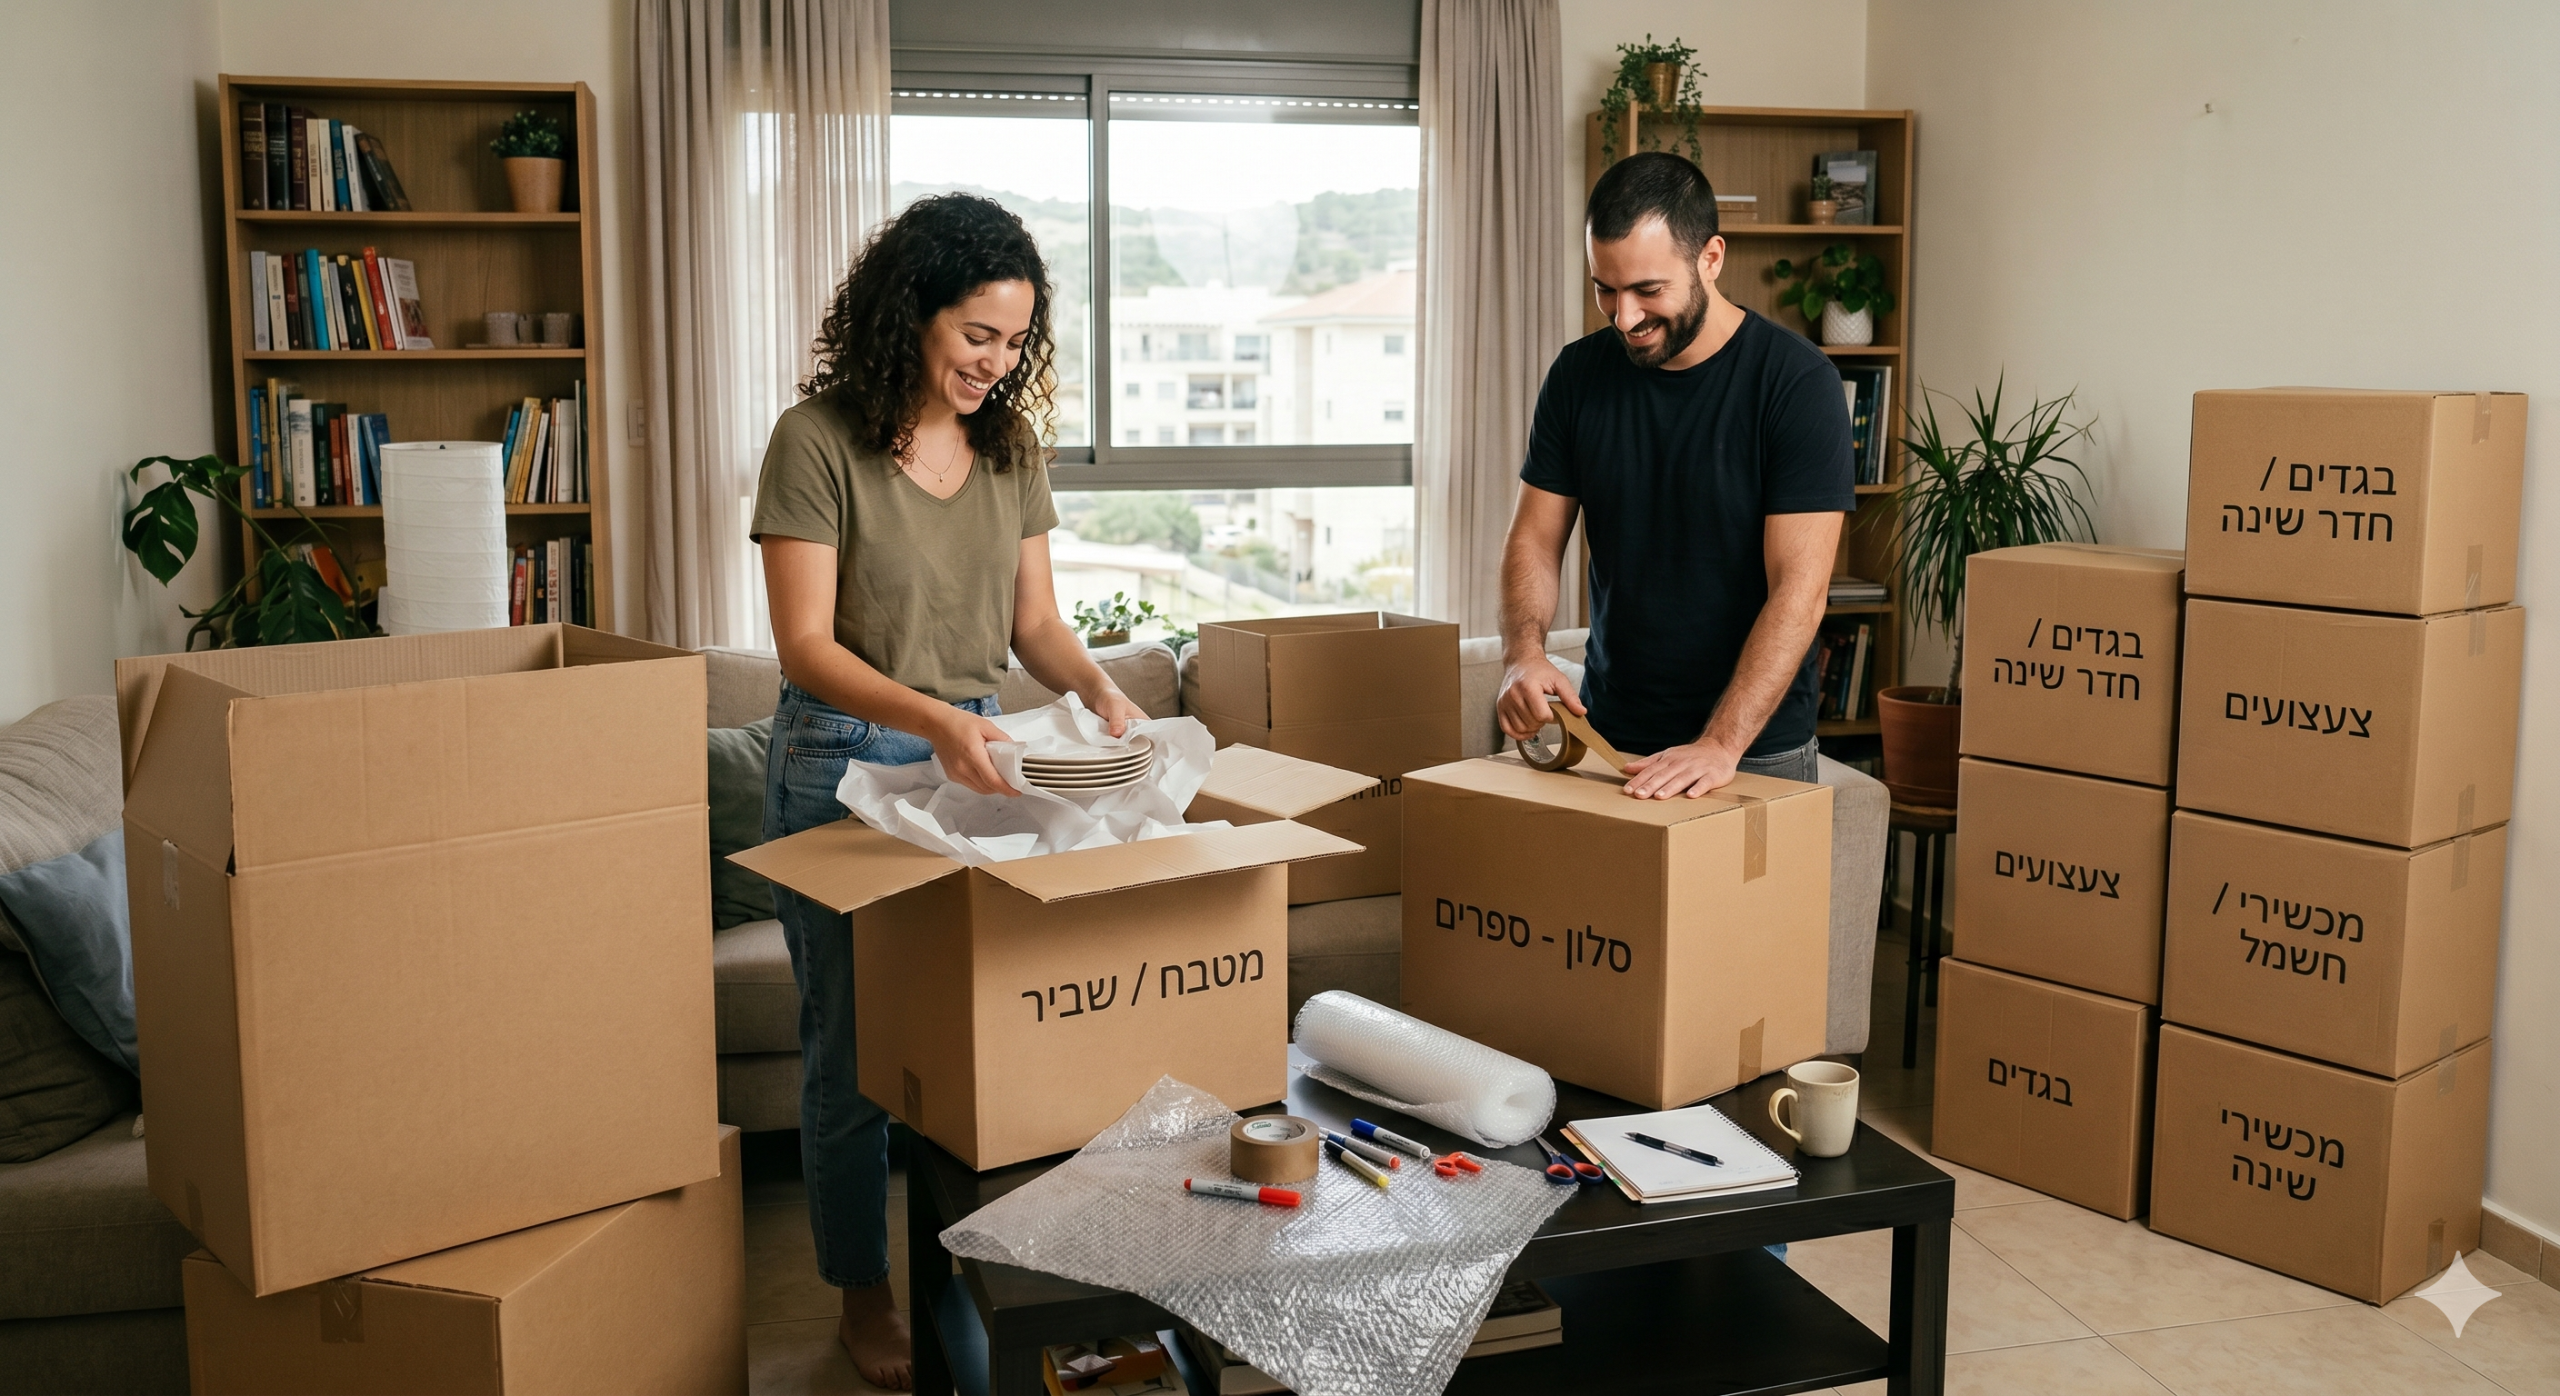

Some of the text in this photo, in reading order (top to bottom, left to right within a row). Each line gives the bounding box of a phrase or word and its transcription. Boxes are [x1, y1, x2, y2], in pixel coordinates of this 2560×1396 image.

[2259, 456, 2397, 496] בגדים /
[2222, 504, 2393, 542] חדר שינה
[2027, 617, 2144, 660] בגדים /
[1993, 657, 2140, 701] חדר שינה
[2225, 692, 2373, 739] צעצועים
[1995, 850, 2121, 900] צעצועים
[1435, 897, 1531, 948] ספרים
[2211, 881, 2364, 943] מכשירי /
[1565, 924, 1632, 974] סלון
[2239, 927, 2347, 985] חשמל
[1021, 949, 1263, 1022] מטבח / שביר
[1987, 1057, 2074, 1108] בגדים
[2221, 1108, 2345, 1170] מכשירי
[2232, 1153, 2317, 1202] שינה
